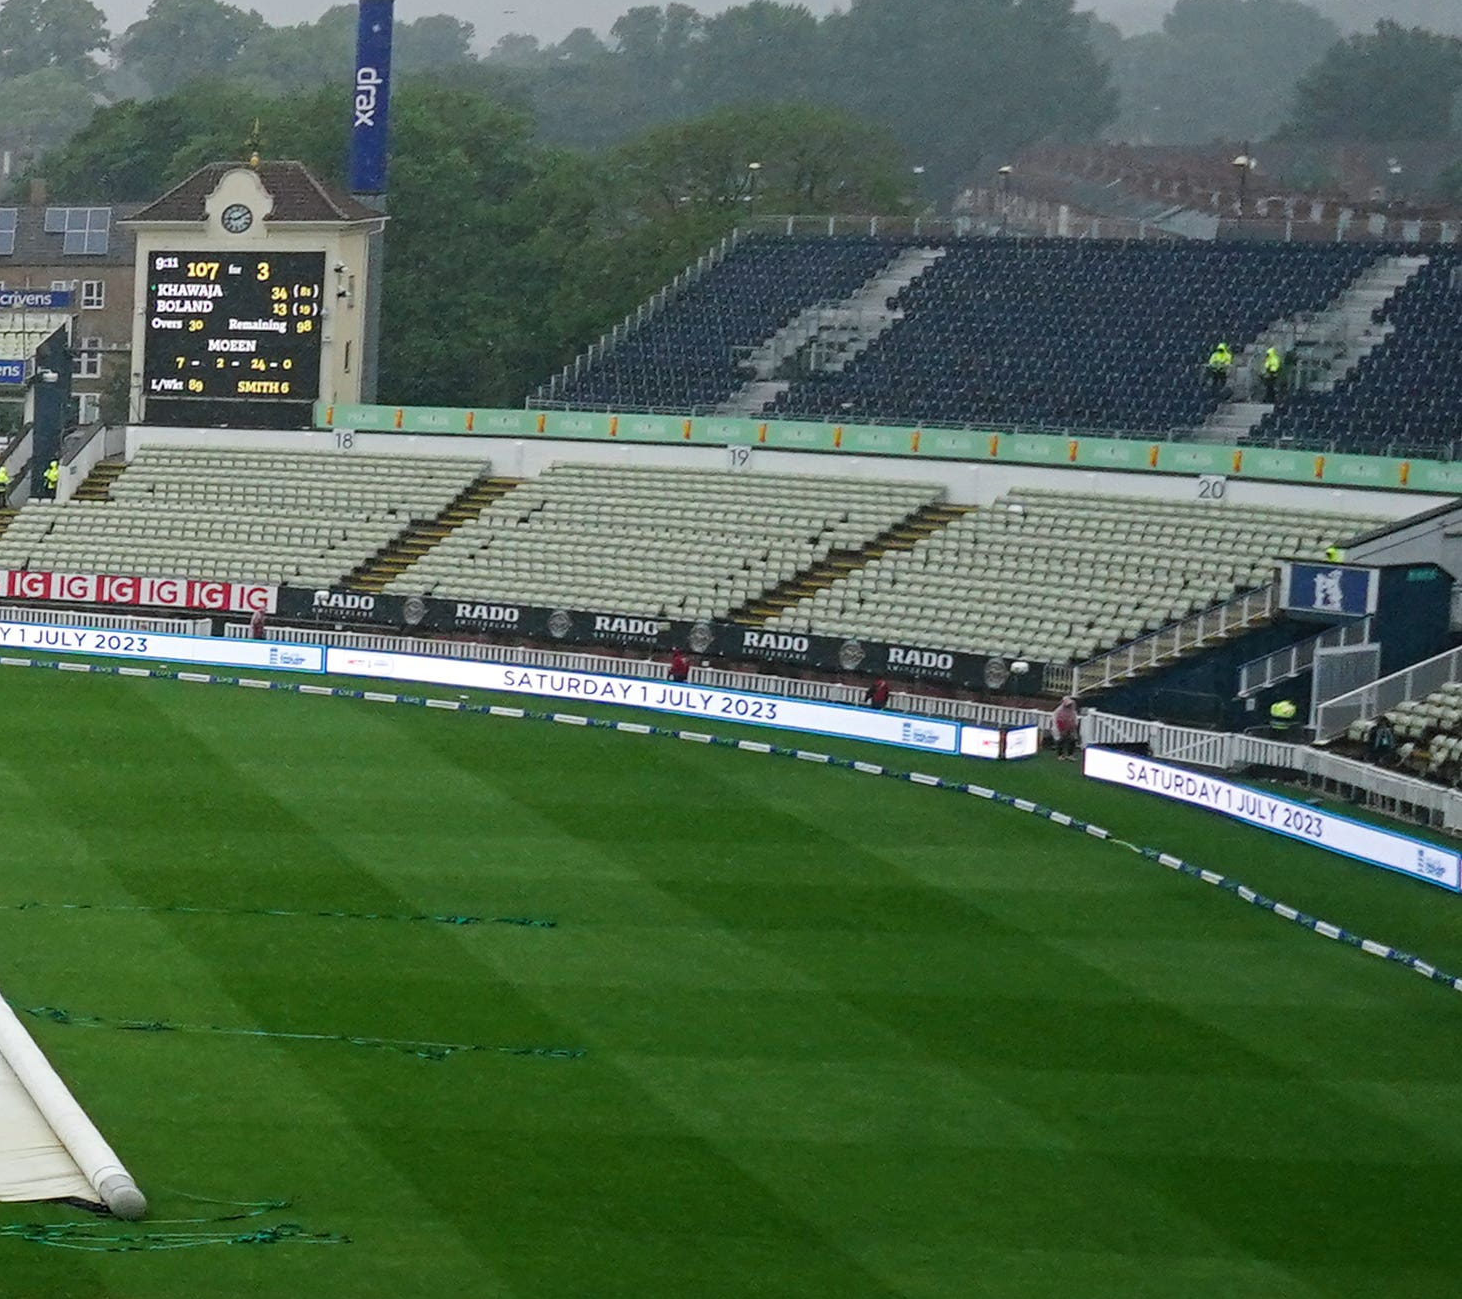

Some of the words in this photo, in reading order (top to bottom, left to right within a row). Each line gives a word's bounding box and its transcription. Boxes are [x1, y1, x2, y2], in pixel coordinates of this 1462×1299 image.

[353, 66, 383, 128] drax
[155, 258, 179, 270] 9:11
[187, 262, 219, 280] 107
[257, 262, 270, 280] 3
[157, 283, 223, 300] KHAWAJA
[271, 287, 288, 300] 34
[156, 301, 213, 313] BOLAND
[272, 304, 288, 316] 13
[151, 318, 183, 330] Overs
[188, 319, 204, 331] 30
[228, 318, 288, 334] Remaining
[297, 320, 313, 333] 98
[208, 340, 257, 352] MOEEN
[176, 357, 185, 369] 7
[216, 358, 224, 369] 2
[250, 358, 266, 371] 24
[283, 359, 292, 369] 0
[151, 379, 184, 391] L/Wkt
[188, 379, 204, 393] 89
[237, 381, 280, 394] SMITH
[280, 382, 290, 394] 6
[336, 432, 354, 449] 18
[730, 449, 750, 467] 19
[1198, 481, 1225, 499] 20
[15, 572, 44, 596] IG
[194, 582, 224, 608] IG
[457, 604, 519, 623] RADO
[594, 616, 660, 636] RADO
[34, 630, 86, 648] JULY
[94, 634, 148, 652] 2023
[743, 631, 809, 652] RADO
[888, 648, 953, 670] RADO
[504, 670, 632, 700] SATURDAY
[656, 689, 713, 711] JULY
[721, 696, 777, 720] 2023
[1127, 762, 1222, 807] SATURDAY
[1237, 792, 1278, 824] JULY
[1284, 807, 1324, 838] 2023
